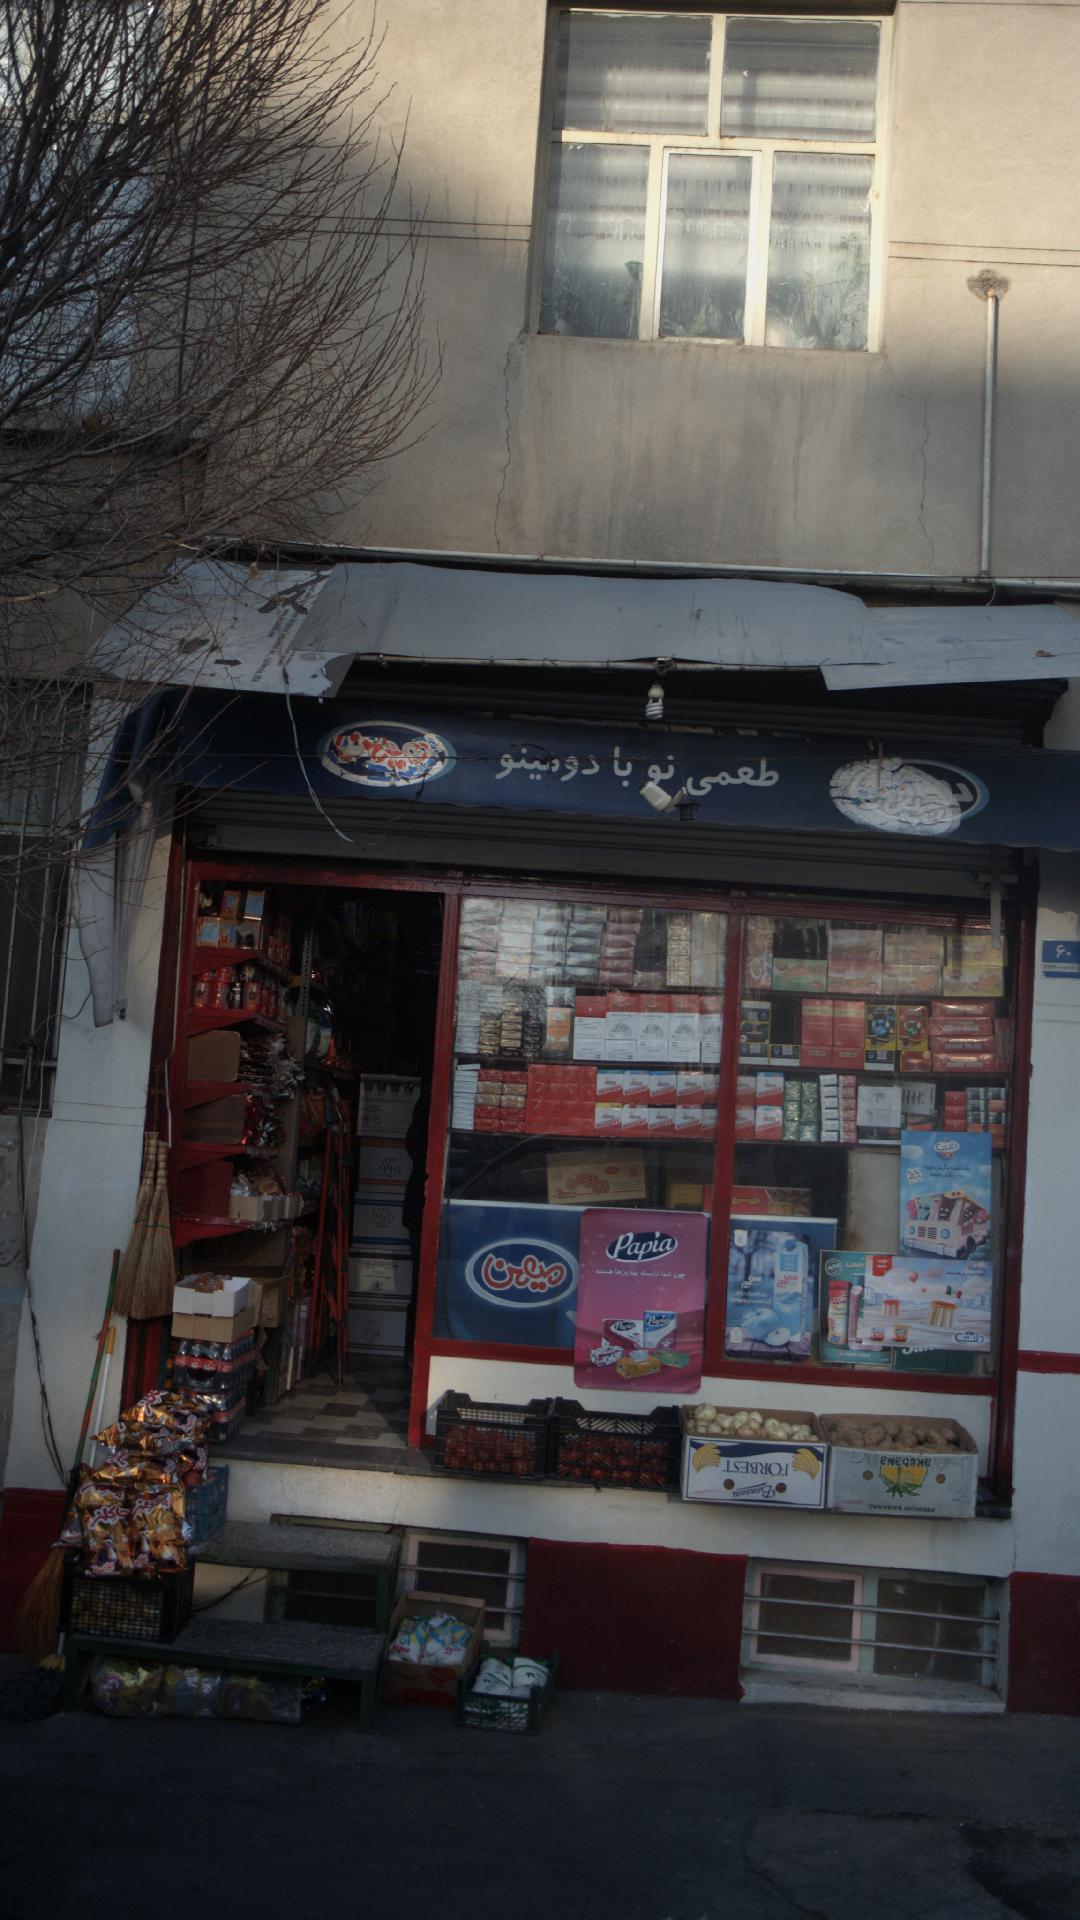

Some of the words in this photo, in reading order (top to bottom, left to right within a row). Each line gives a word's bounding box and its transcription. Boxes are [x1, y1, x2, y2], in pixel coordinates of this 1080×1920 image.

[495, 747, 601, 782] دومینو
[613, 746, 633, 788] با
[646, 754, 676, 784] نو
[686, 755, 780, 797] طعمی
[616, 1231, 673, 1261] Papia
[481, 1252, 568, 1293] میهن
[722, 1460, 789, 1477] FORBEST
